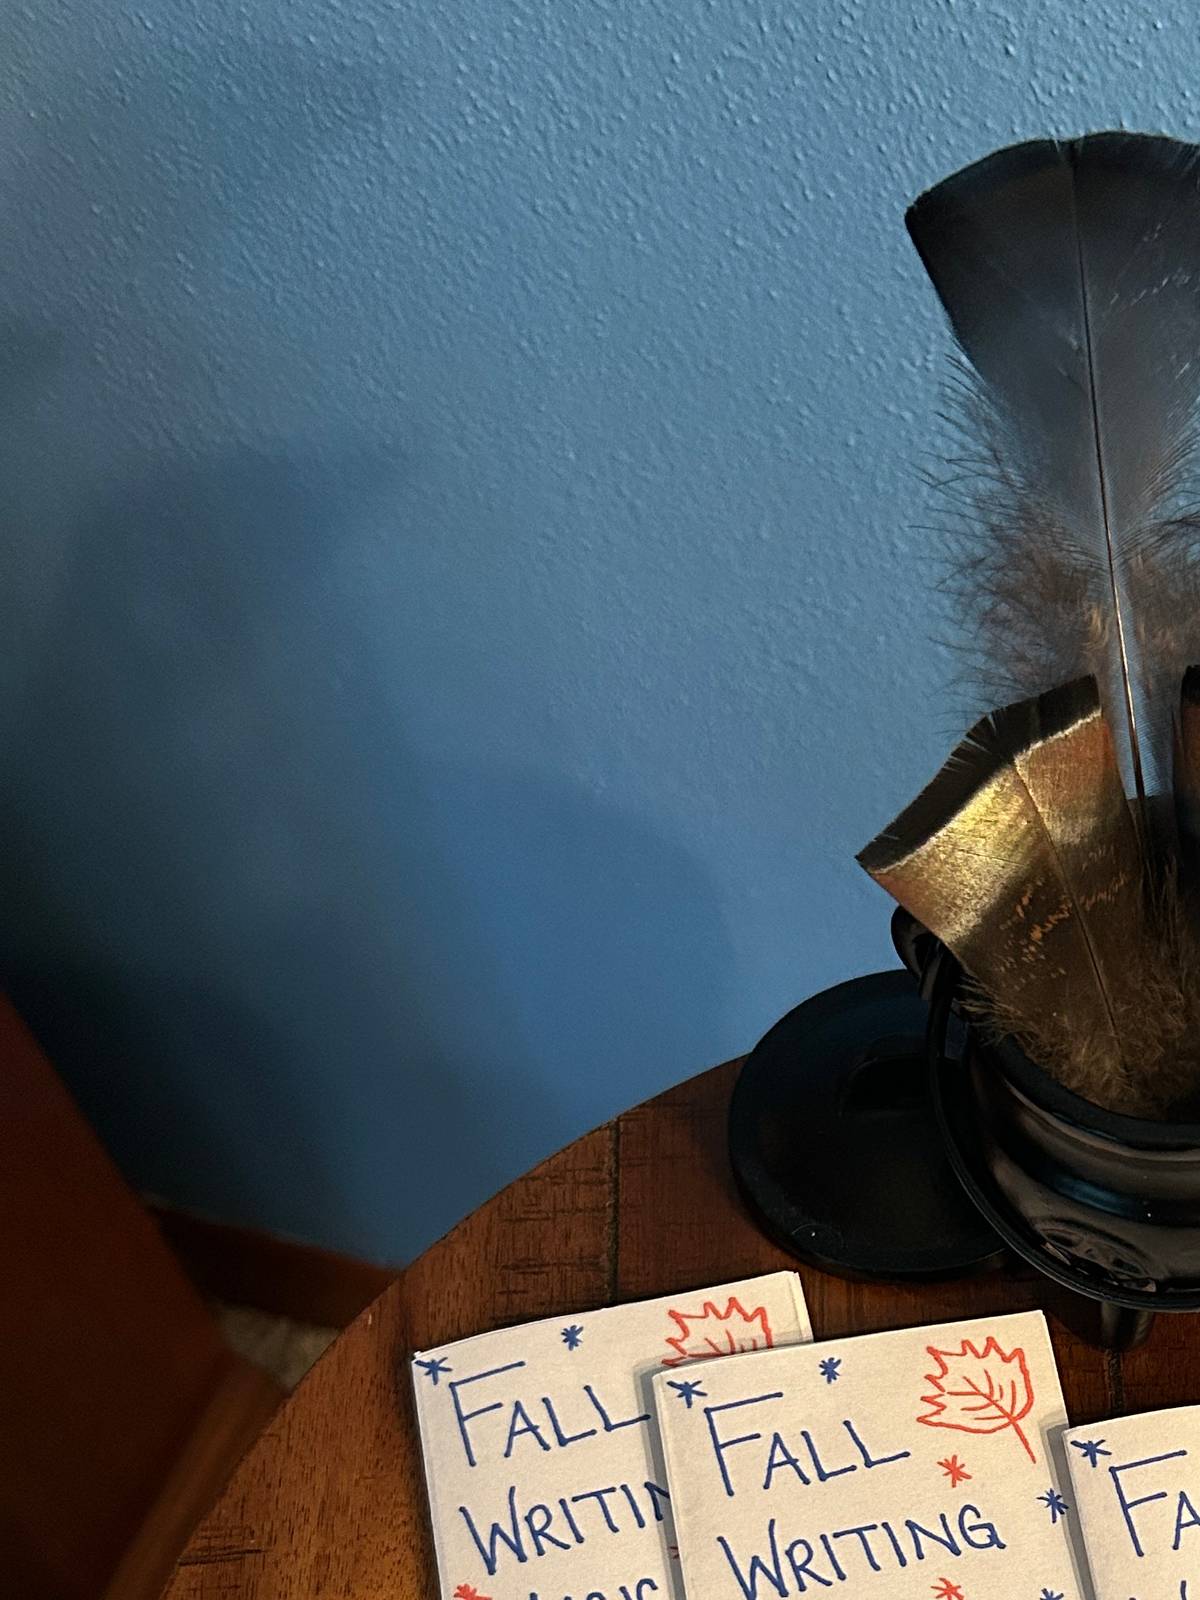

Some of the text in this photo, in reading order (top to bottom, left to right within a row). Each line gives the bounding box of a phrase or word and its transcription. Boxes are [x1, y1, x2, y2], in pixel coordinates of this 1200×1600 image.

[447, 1359, 652, 1467] FALL
[703, 1391, 911, 1497] FALL
[459, 1481, 670, 1576] WRITIN
